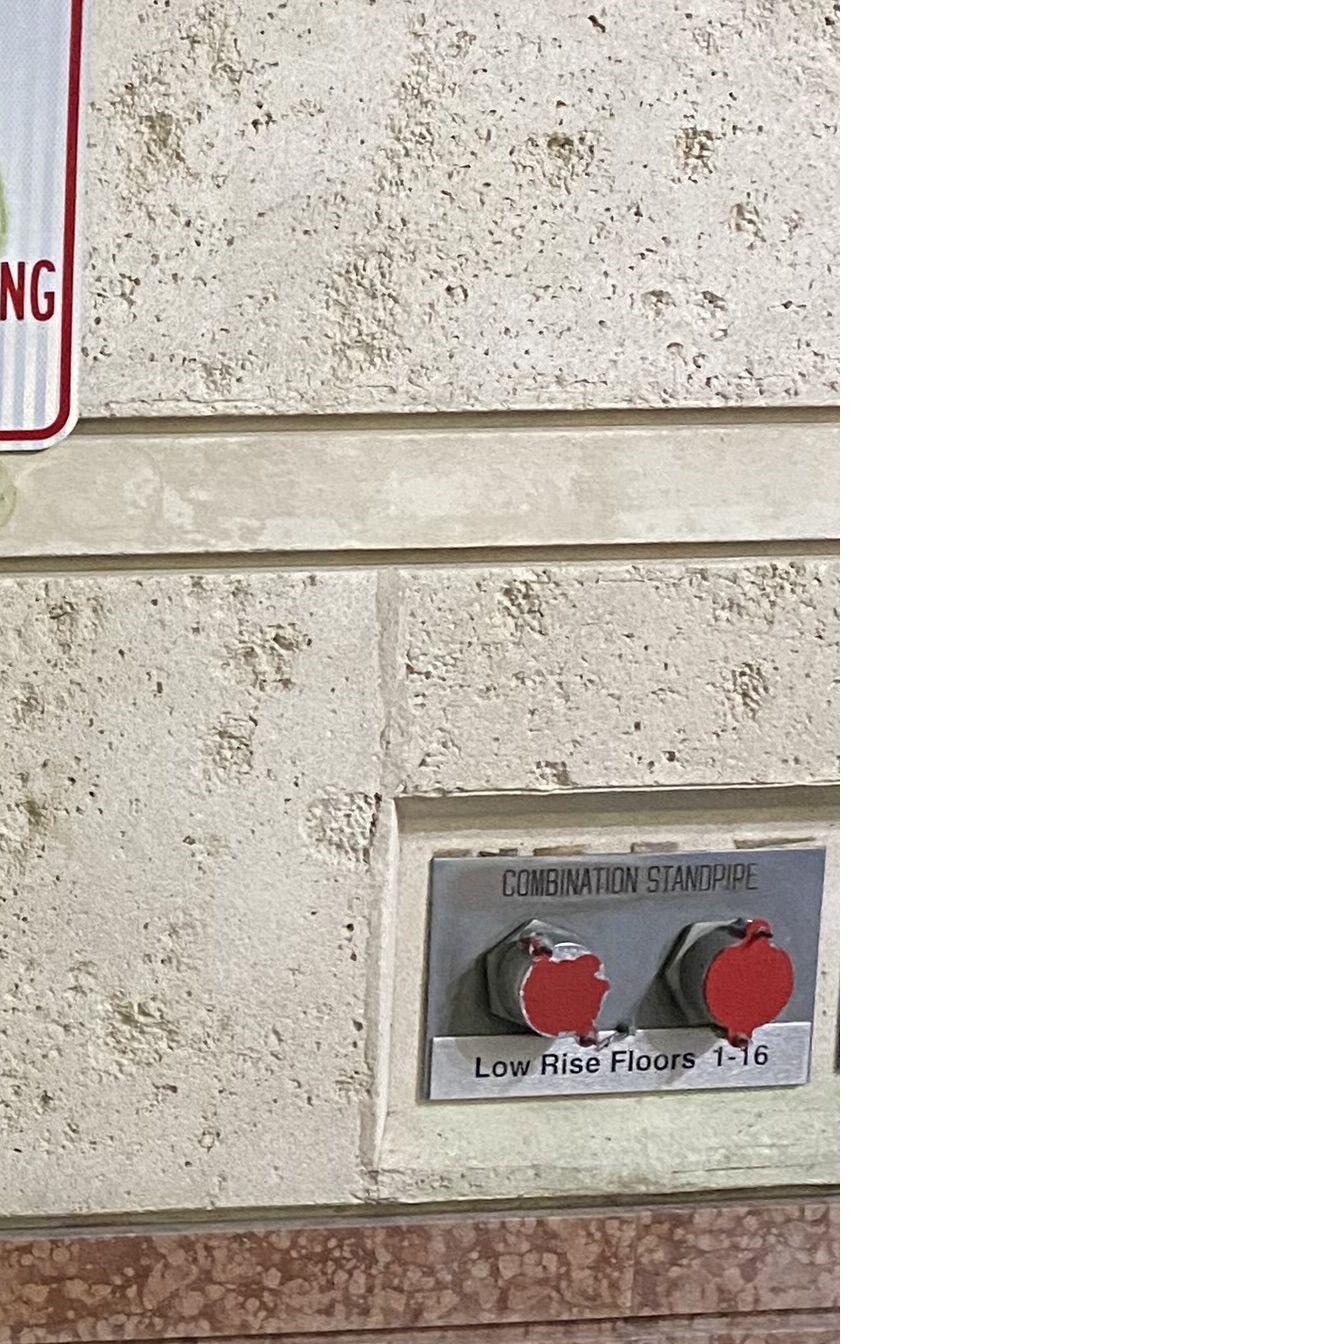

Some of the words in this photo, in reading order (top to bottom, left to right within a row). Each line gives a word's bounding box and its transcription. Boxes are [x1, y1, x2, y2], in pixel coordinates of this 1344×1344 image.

[502, 865, 639, 897] COMBINATION
[647, 862, 760, 893] STANDPIPE
[475, 1057, 531, 1078] Low
[541, 1053, 600, 1075] Rise
[611, 1049, 695, 1072] Floors
[713, 1045, 769, 1067] 1-16
